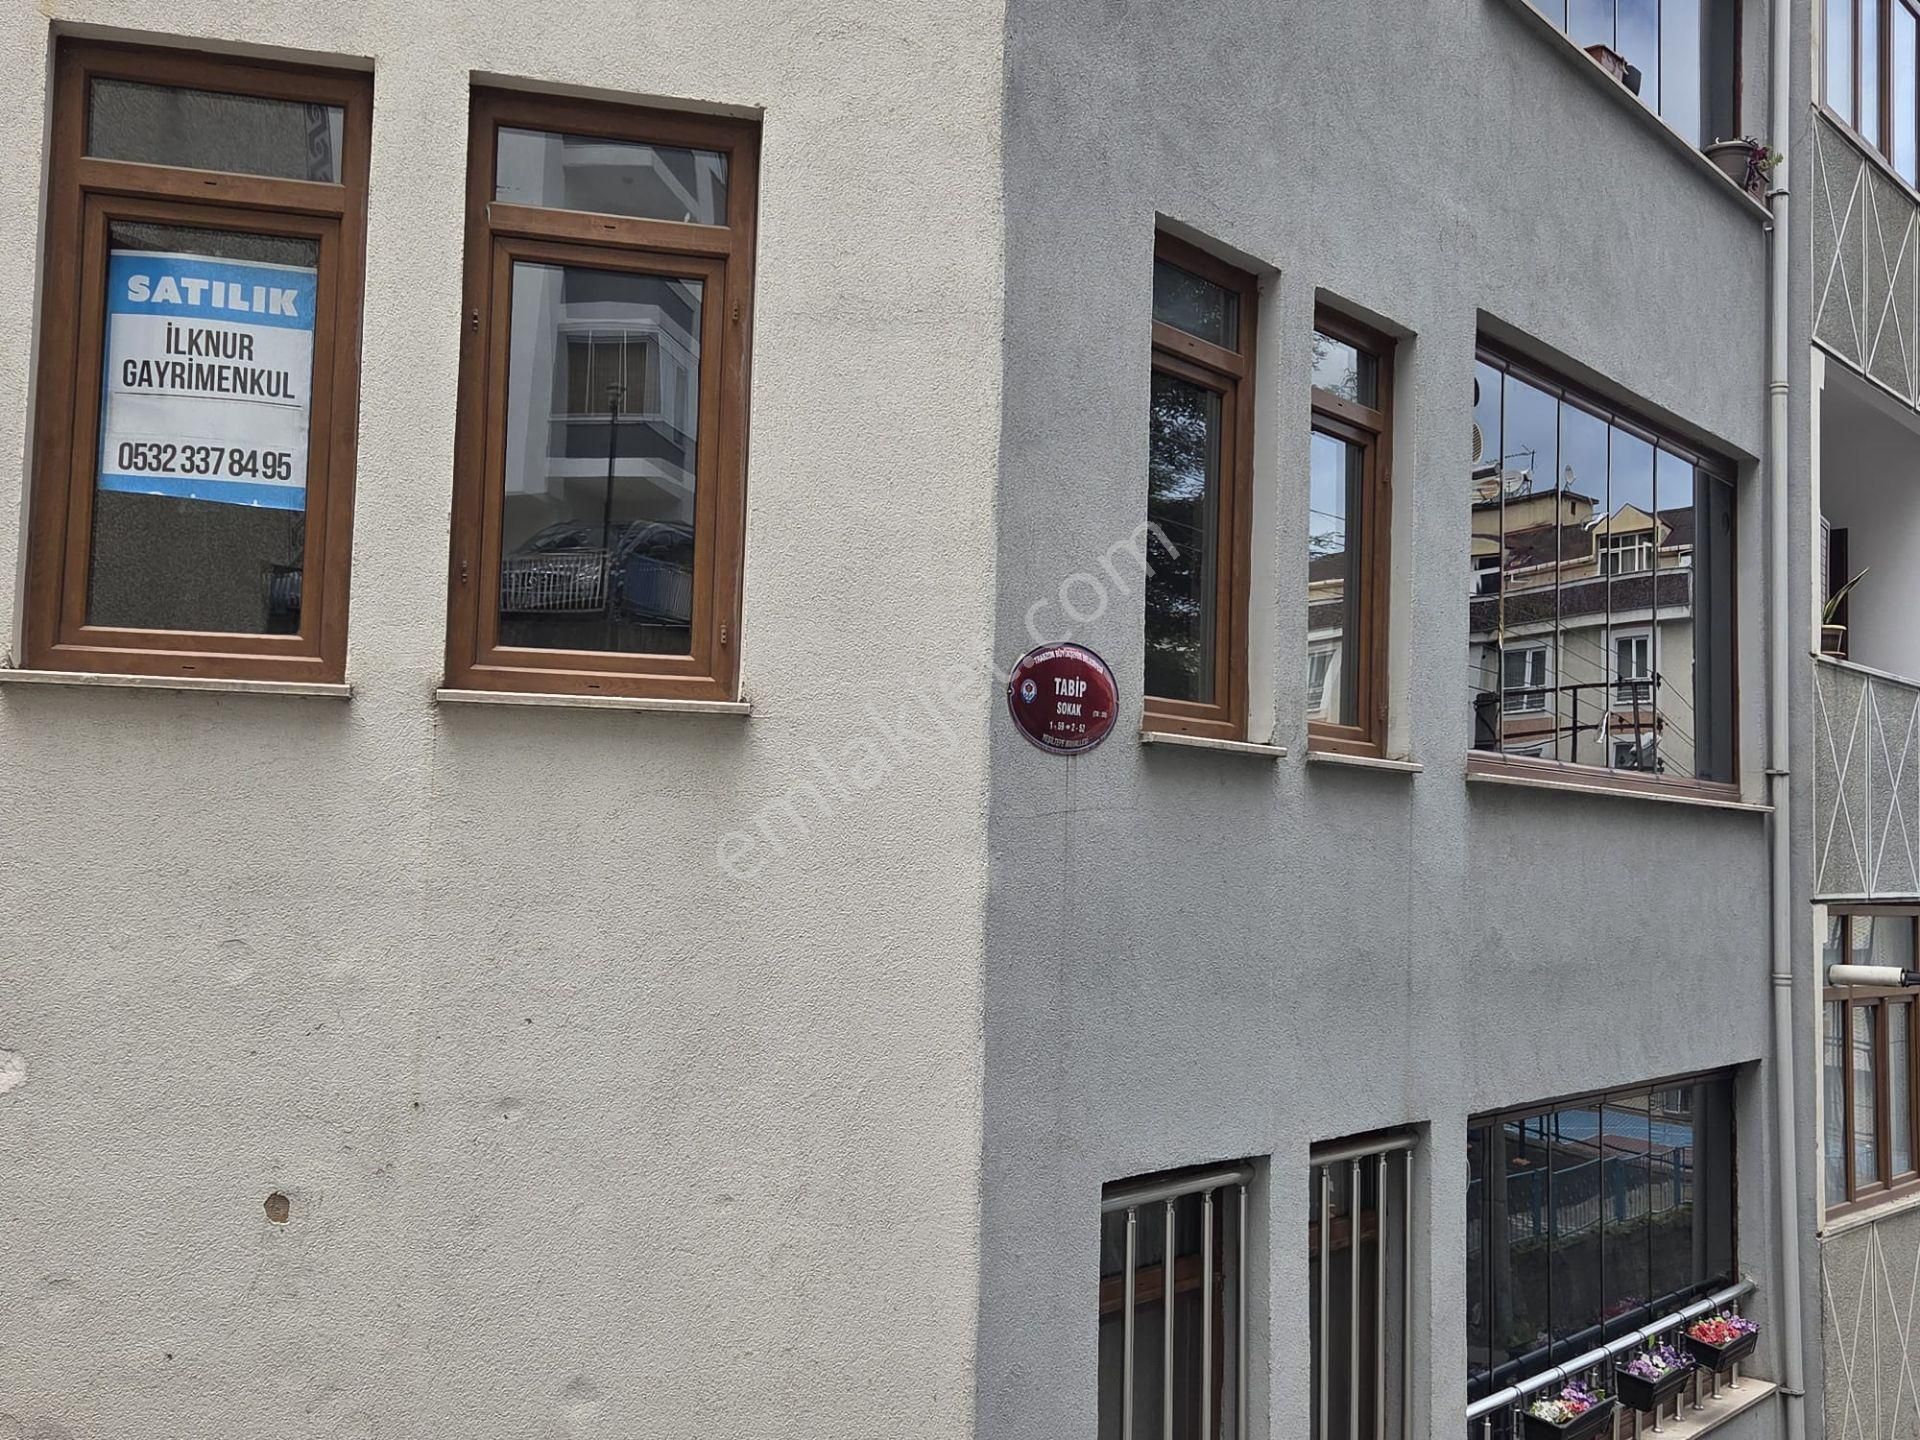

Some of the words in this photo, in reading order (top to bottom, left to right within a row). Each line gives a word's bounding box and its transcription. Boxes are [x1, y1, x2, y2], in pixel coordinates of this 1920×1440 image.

[127, 274, 299, 317] SATILIK
[165, 321, 255, 361] İLKNUR
[122, 357, 296, 399] GAYRİMENKUL
[118, 442, 176, 472] 0532
[180, 445, 226, 475] 337
[228, 448, 259, 477] 84
[262, 451, 292, 480] 95
[1054, 676, 1087, 698] TABİP
[1056, 702, 1082, 717] SOKAK
